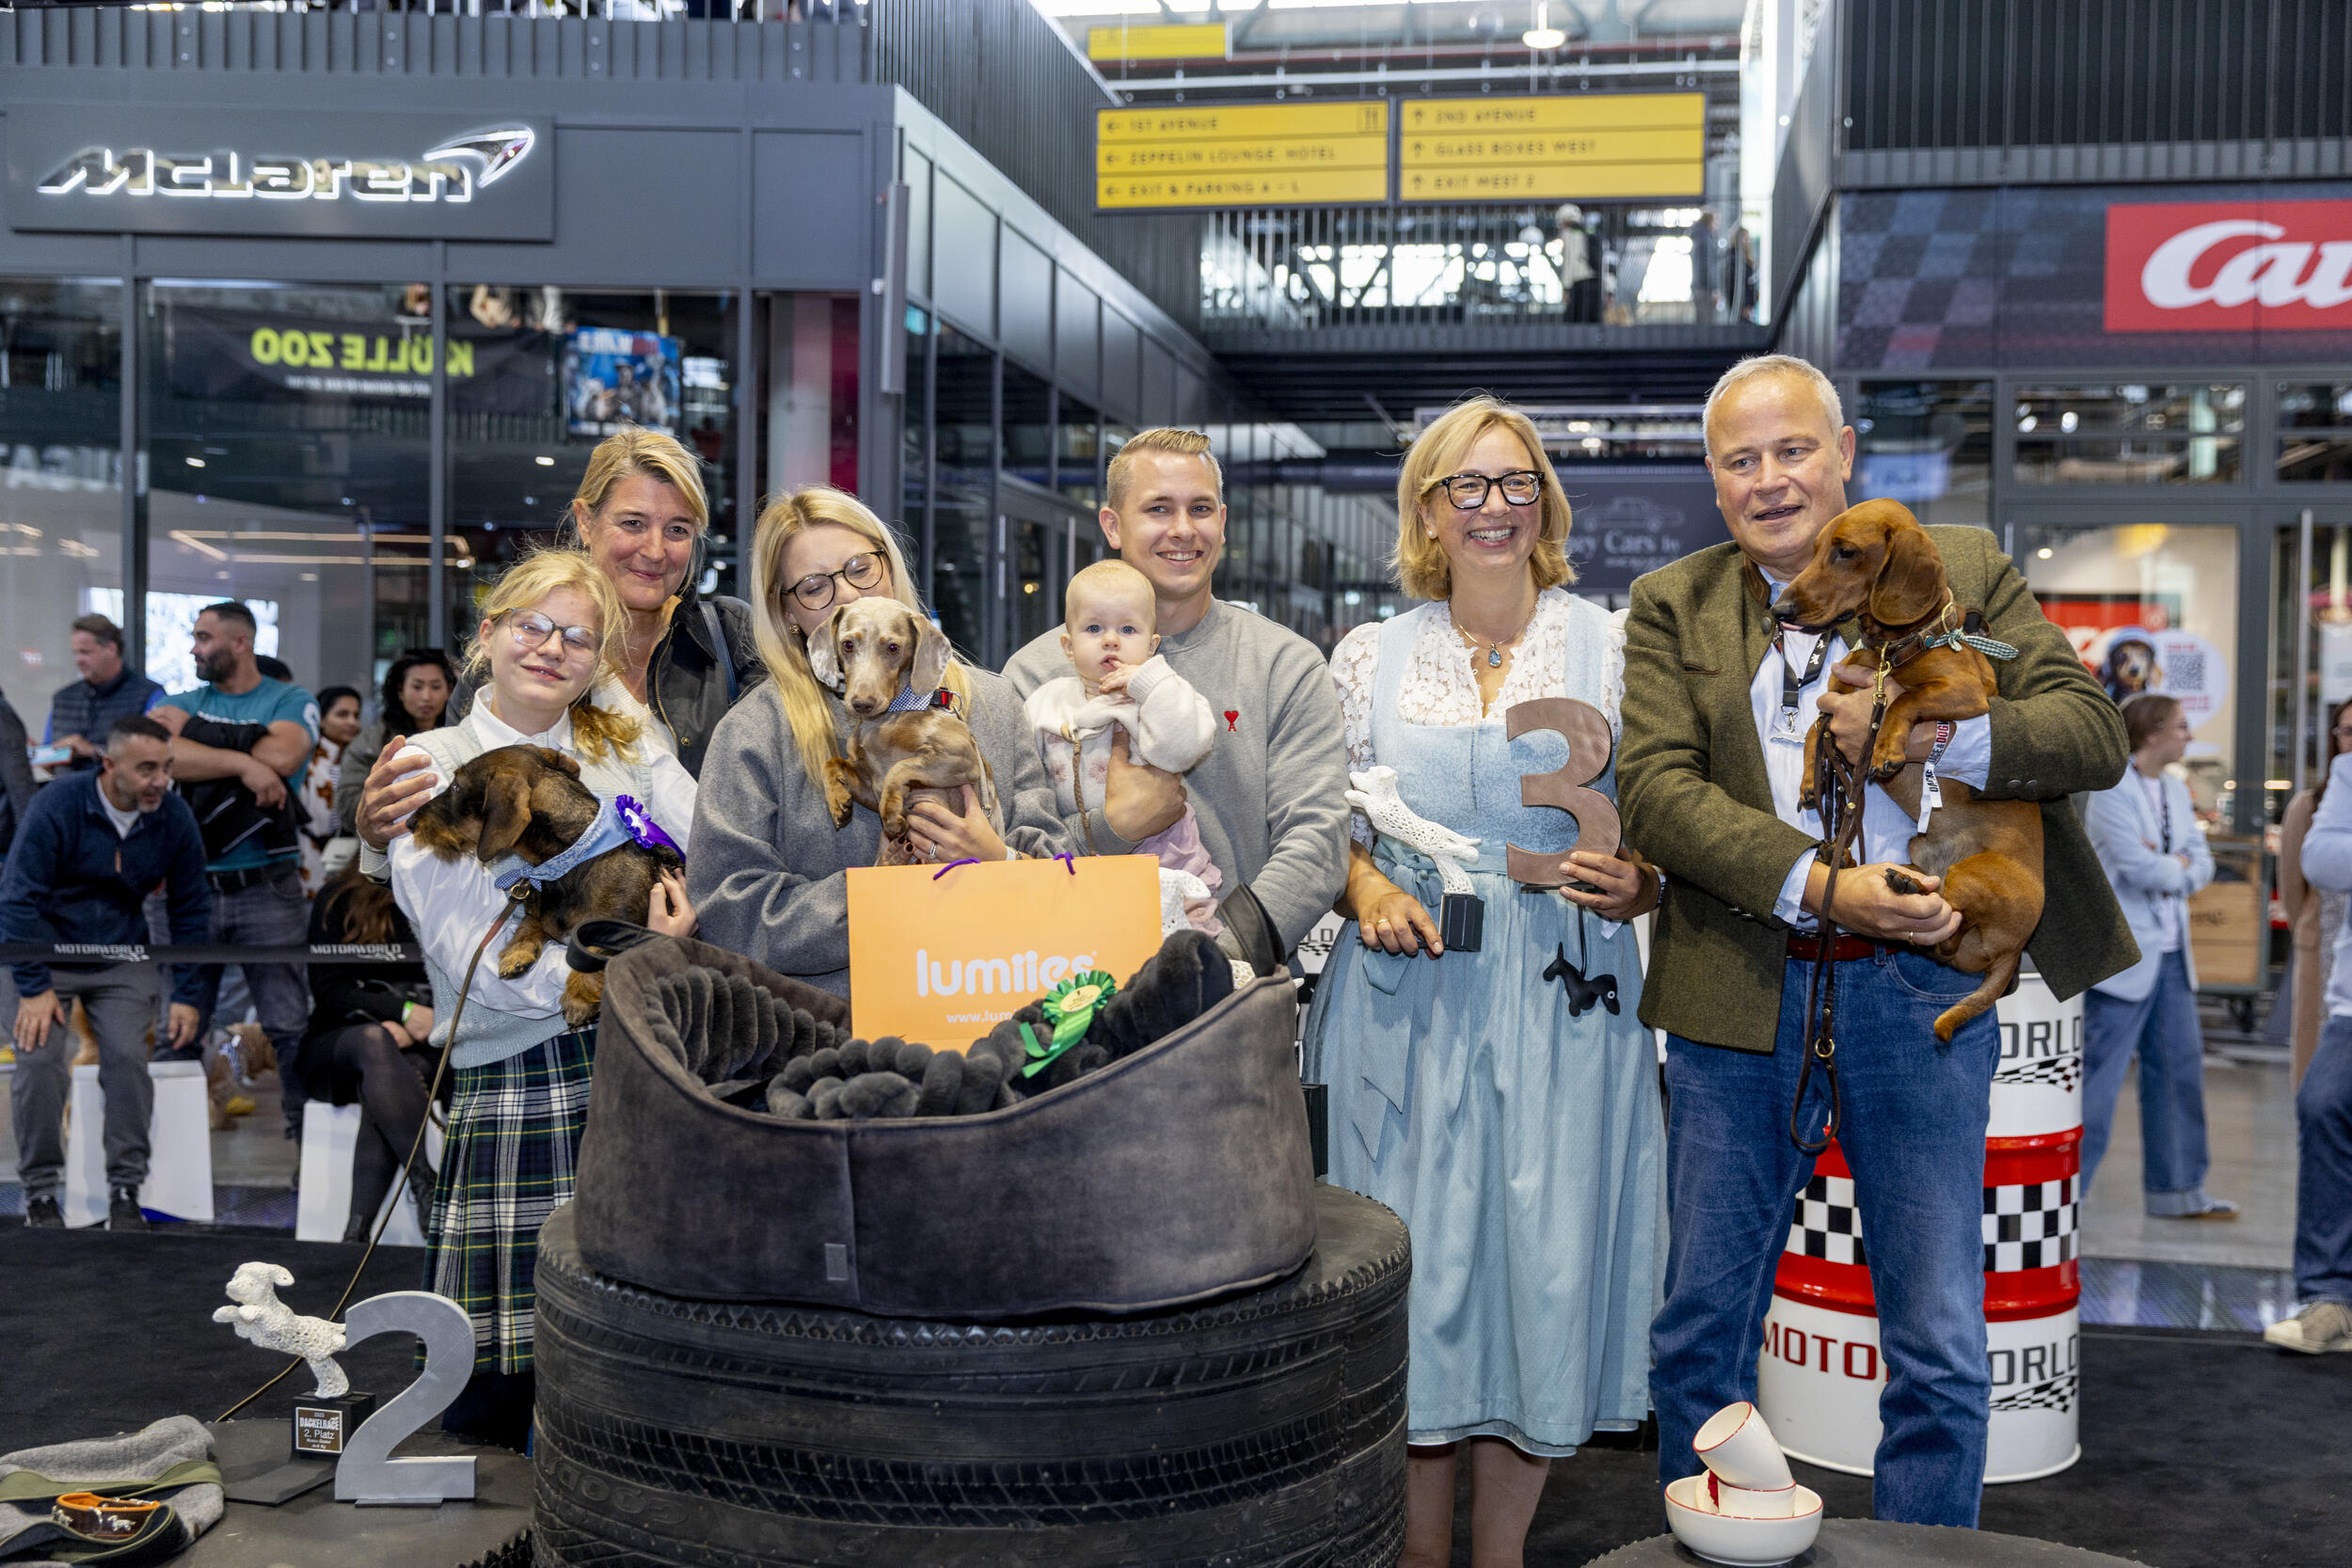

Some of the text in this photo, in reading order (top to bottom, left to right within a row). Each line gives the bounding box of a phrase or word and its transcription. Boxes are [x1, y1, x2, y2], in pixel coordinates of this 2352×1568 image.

[1130, 114, 1219, 132] 1ST AVENUE
[1436, 106, 1536, 124] 2ND AVENUE
[1129, 149, 1203, 166] ZEPPELIN
[1285, 144, 1337, 161] HOTEL
[1435, 138, 1597, 157] GLASS BOXES WEST
[39, 147, 472, 202] McLaren
[1434, 173, 1535, 190] EXIT WEST 2
[1129, 182, 1162, 198] EXIT
[1185, 181, 1254, 196] PARKING
[1506, 698, 1622, 885] 3
[54, 943, 145, 955] MOTORWORLD
[310, 943, 402, 955] MOTORWORLD
[1762, 1321, 1890, 1383] MOTO
[335, 1291, 476, 1500] 2
[304, 1428, 335, 1440] 2. Platz
